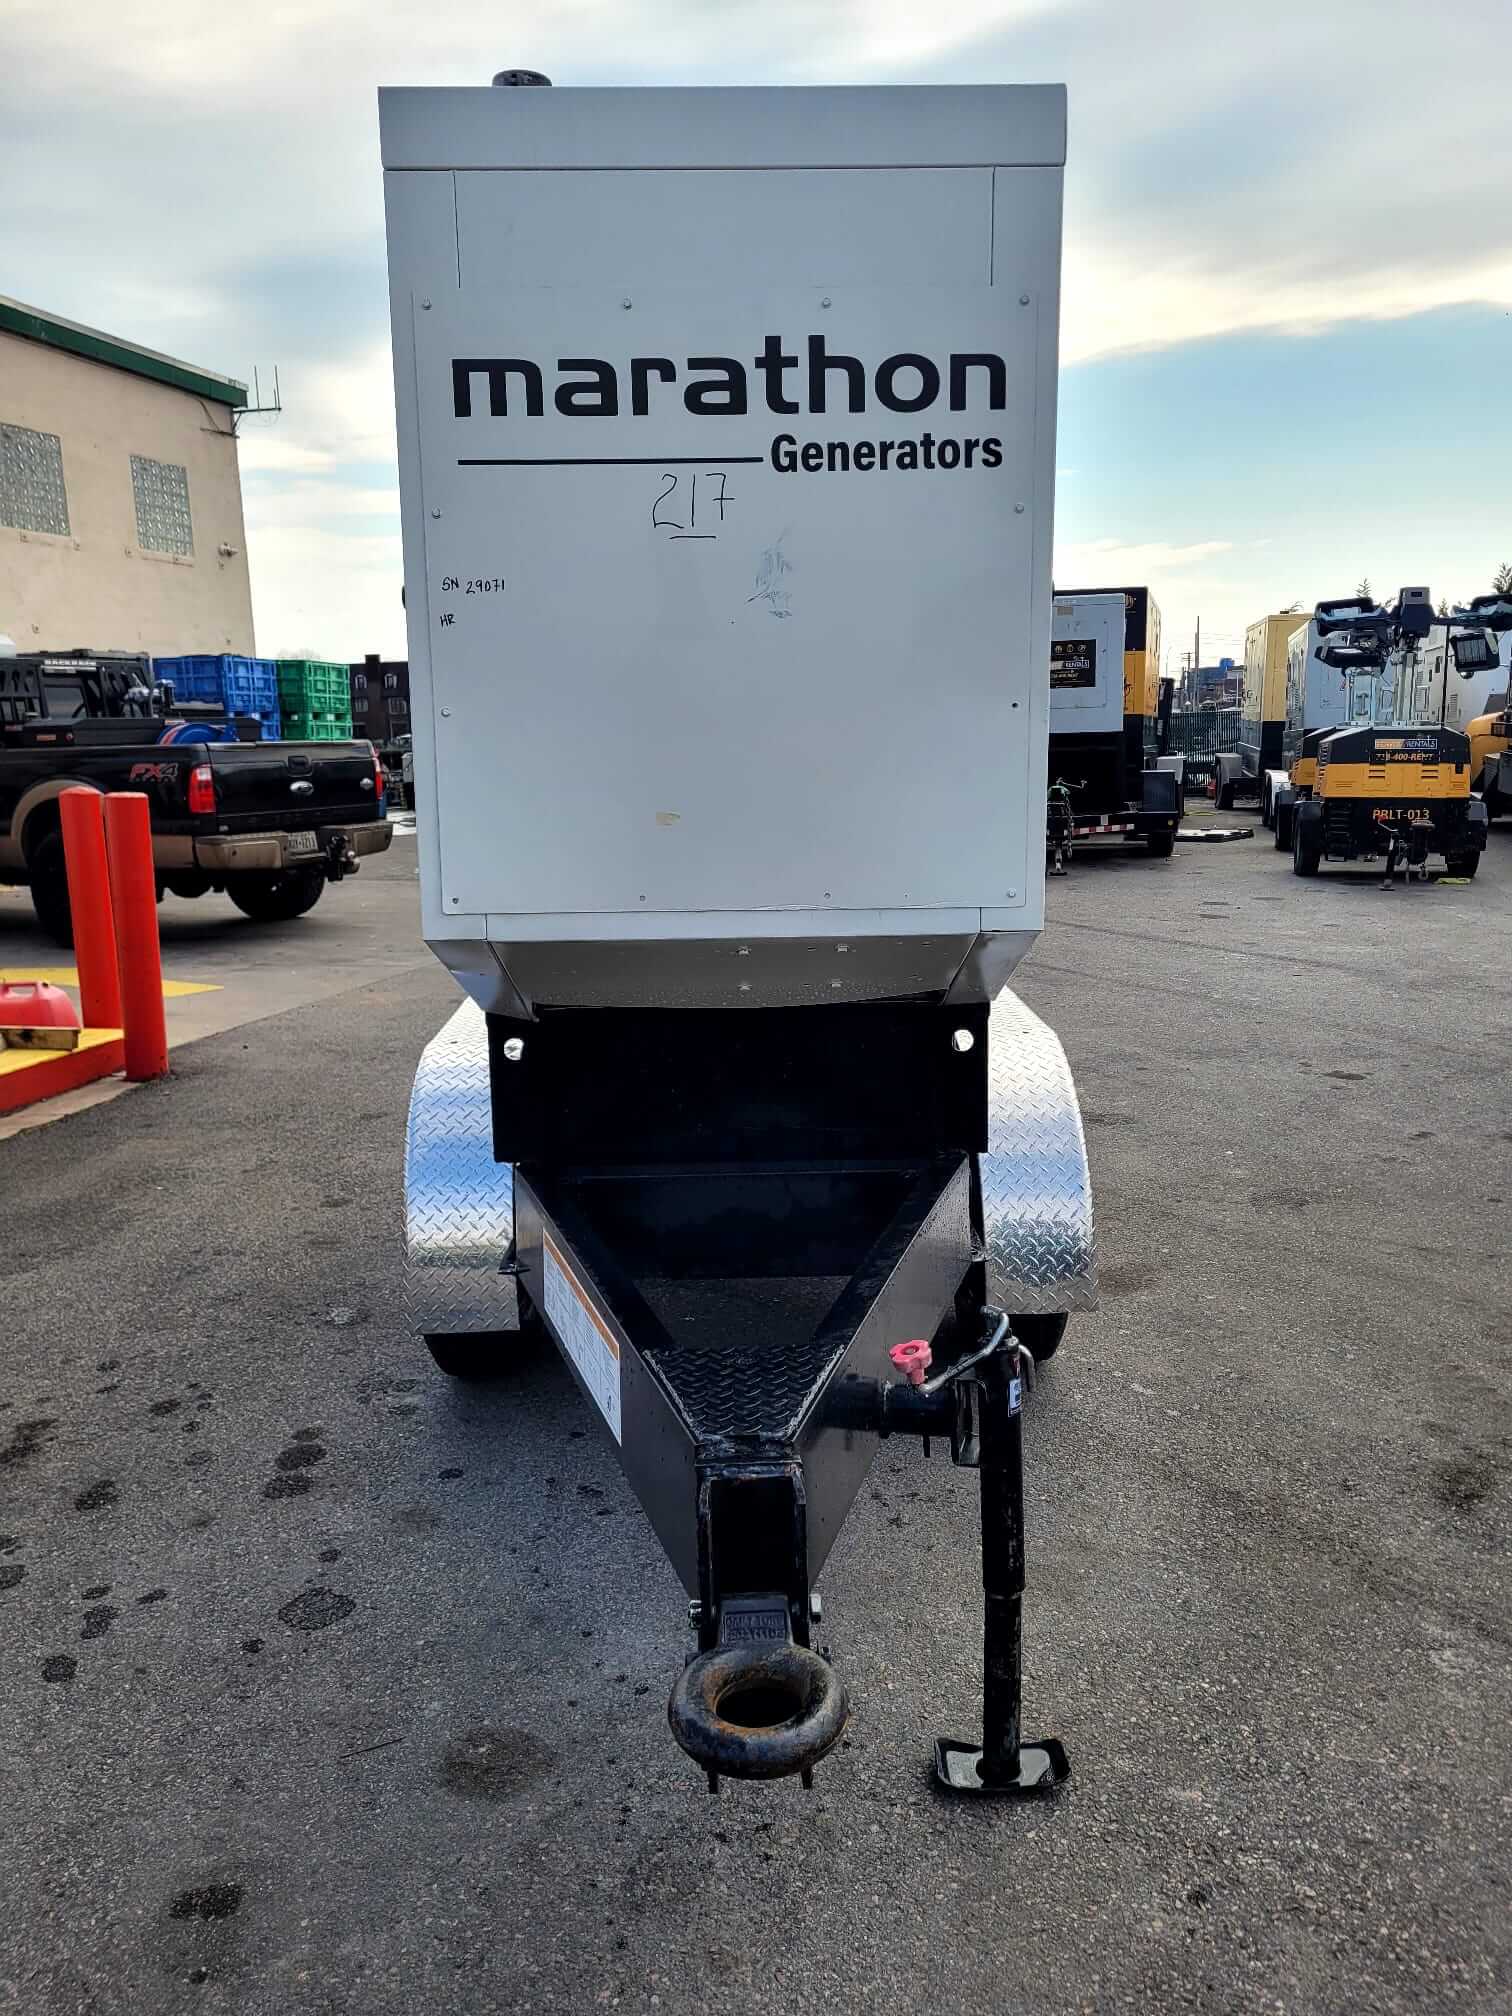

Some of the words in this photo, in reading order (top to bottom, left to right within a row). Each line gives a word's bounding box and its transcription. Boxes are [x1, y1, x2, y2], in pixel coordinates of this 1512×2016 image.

[452, 335, 1007, 417] marathon
[771, 433, 1003, 473] Generators
[652, 473, 736, 529] 217
[441, 576, 460, 591] SN
[465, 578, 505, 595] 29071
[440, 613, 457, 629] HR
[1406, 739, 1436, 748] RENTALS
[129, 763, 178, 781] FX4
